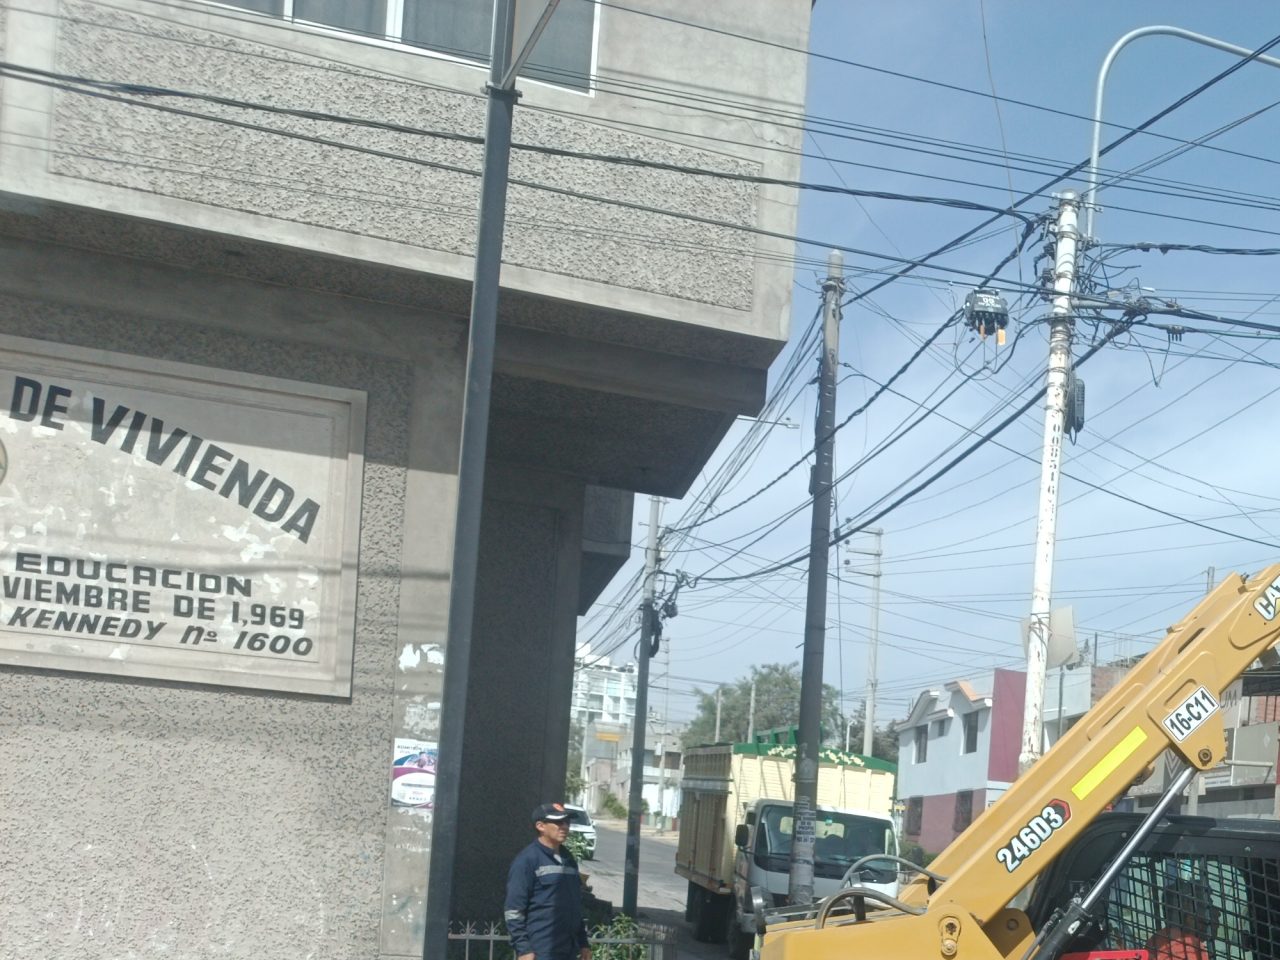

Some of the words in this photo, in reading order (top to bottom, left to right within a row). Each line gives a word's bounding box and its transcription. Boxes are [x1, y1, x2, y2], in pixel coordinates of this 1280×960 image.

[9, 376, 72, 431] DE
[90, 397, 321, 544] VIVIENDA
[2, 575, 151, 614] VIEMBRE
[173, 594, 216, 621] DE
[15, 552, 252, 597] EDUCACION
[7, 606, 167, 641] KENNEDY
[233, 630, 313, 657] 1600
[1168, 689, 1216, 737] 16-C11
[996, 805, 1063, 873] 246D3
